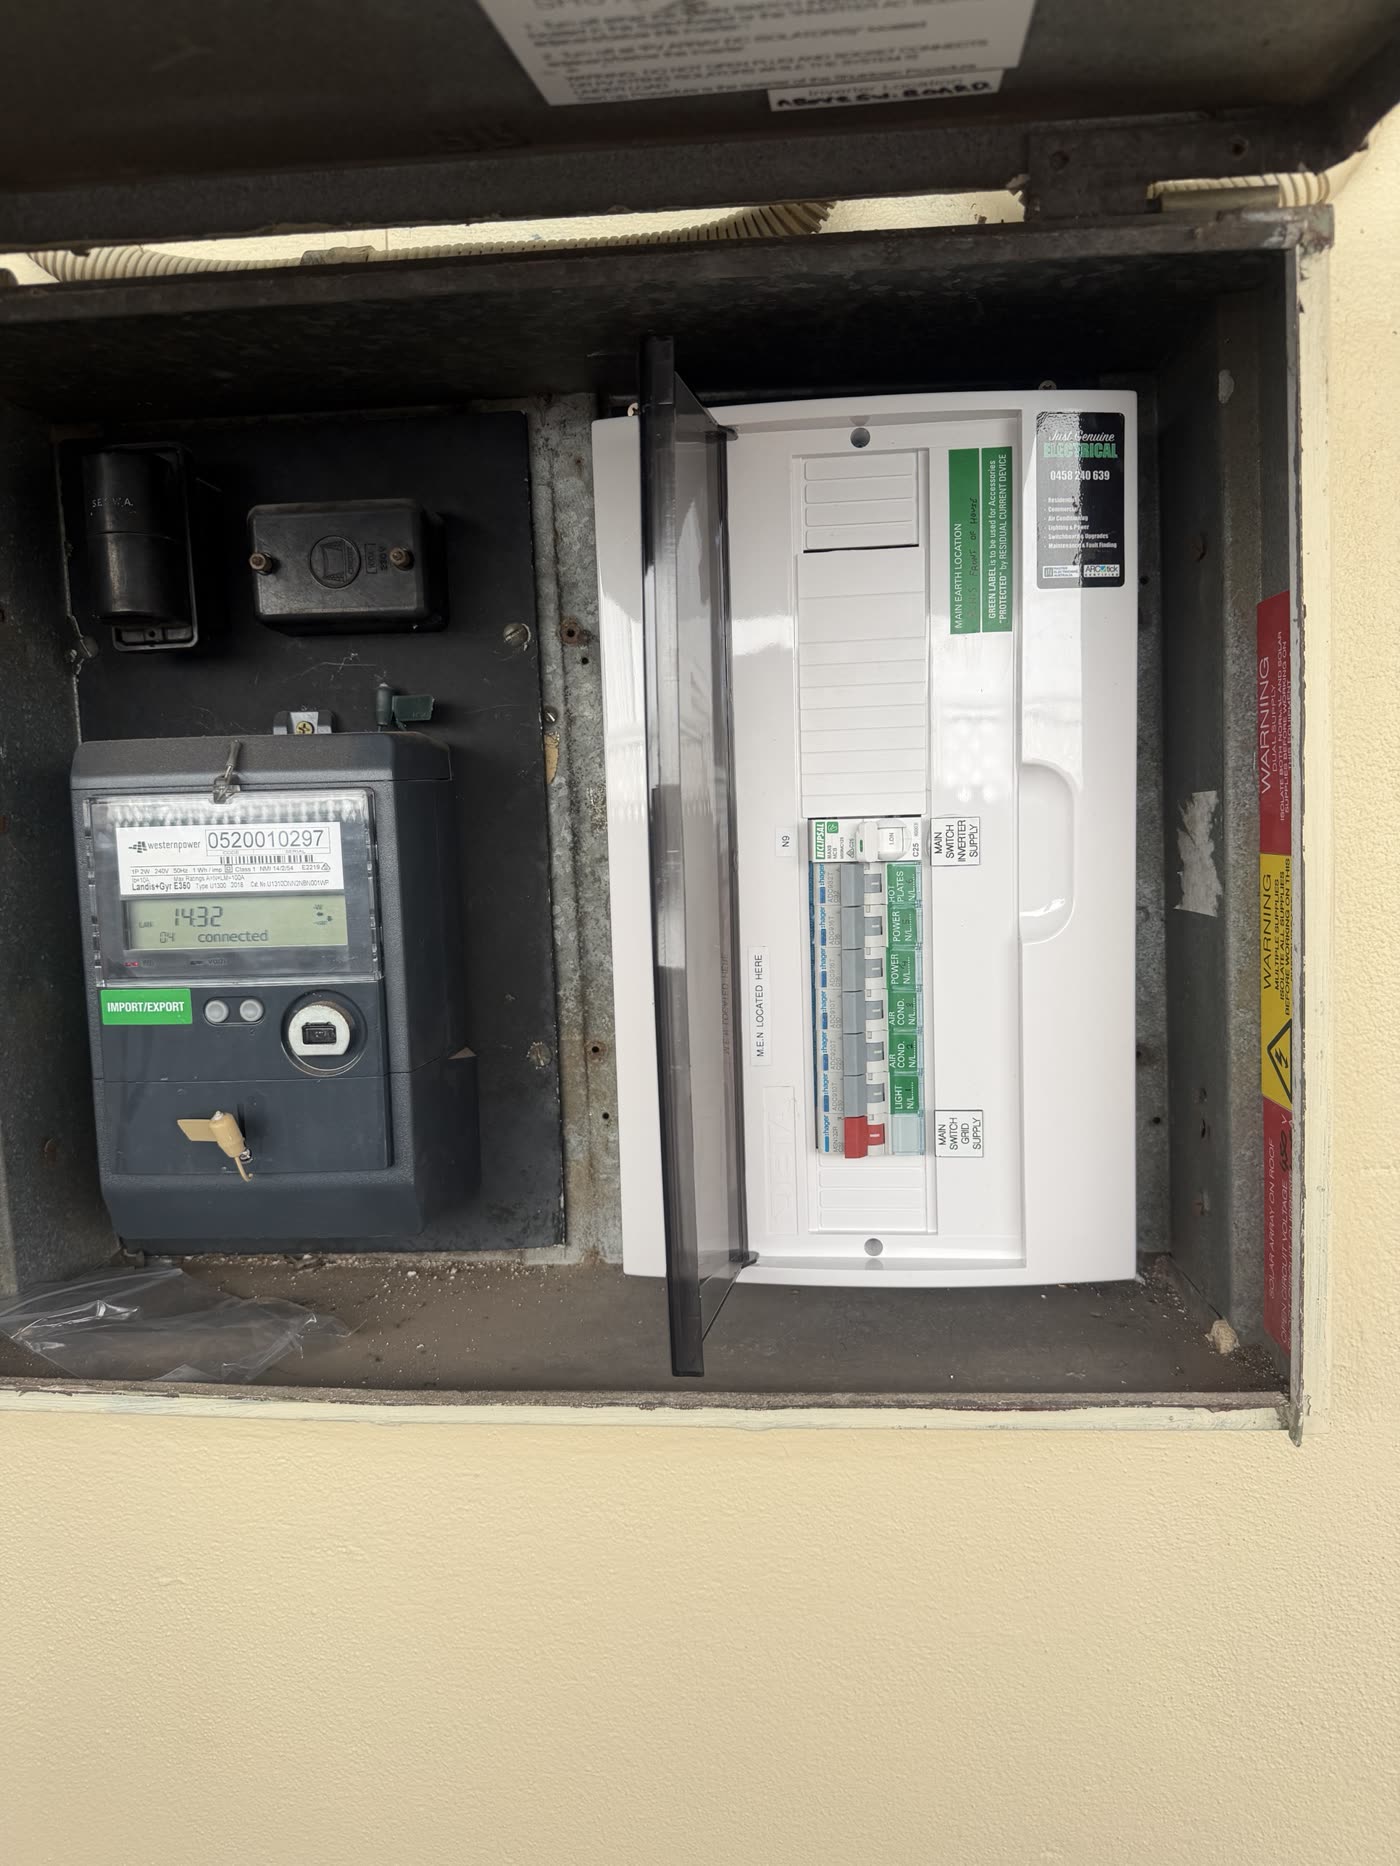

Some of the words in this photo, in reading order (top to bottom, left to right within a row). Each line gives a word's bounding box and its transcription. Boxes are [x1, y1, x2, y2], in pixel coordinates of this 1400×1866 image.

[1074, 429, 1115, 442] Genuine
[1043, 442, 1118, 459] ELECTRICAL
[999, 454, 1007, 482] DEVICE
[1050, 470, 1073, 481] 0458
[1074, 470, 1091, 481] 240
[1092, 470, 1111, 481] 639
[988, 460, 997, 507] Accessories
[988, 508, 996, 519] for
[999, 484, 1007, 520] CURRENT
[969, 531, 977, 541] OF
[988, 520, 996, 538] used
[999, 521, 1007, 559] RESIDUAL
[954, 523, 962, 570] LOCATION
[988, 539, 996, 549] be
[989, 550, 996, 558] to
[999, 560, 1008, 570] by
[954, 572, 962, 602] EARTH
[988, 567, 996, 592] LABEL
[954, 604, 962, 629] MAIN
[988, 593, 996, 619] GREEN
[1259, 656, 1271, 794] WARNING
[147, 841, 201, 853] westernpower
[208, 830, 324, 850] 0520010297
[781, 835, 790, 848] N9
[816, 823, 825, 852] CLIPSAL
[934, 831, 942, 854] MAIN
[945, 824, 954, 859] SWITCH
[957, 819, 966, 862] INVERTER
[969, 823, 978, 858] SUPPLY
[912, 843, 920, 858] C25
[132, 881, 172, 892] Landis+Gyr
[173, 880, 191, 890] E350
[186, 874, 204, 882] Ratings
[896, 870, 904, 902] PLATES
[887, 885, 895, 903] HOT
[197, 929, 268, 943] connected
[892, 911, 900, 941] POWER
[1262, 874, 1271, 990] WARNING
[754, 955, 763, 981] HERE
[891, 954, 899, 985] POWER
[106, 1001, 184, 1014] IMPORT/EXPORT
[755, 985, 764, 1028] LOCATED
[897, 998, 905, 1025] COND.
[755, 1032, 765, 1057] M.E.N
[897, 1041, 905, 1068] COND.
[894, 1084, 903, 1110] LIGHT
[938, 1124, 946, 1146] MAIN
[949, 1117, 958, 1151] SWITCH
[960, 1122, 970, 1145] GRID
[972, 1117, 981, 1150] SUPPLY
[1268, 1181, 1275, 1205] ON
